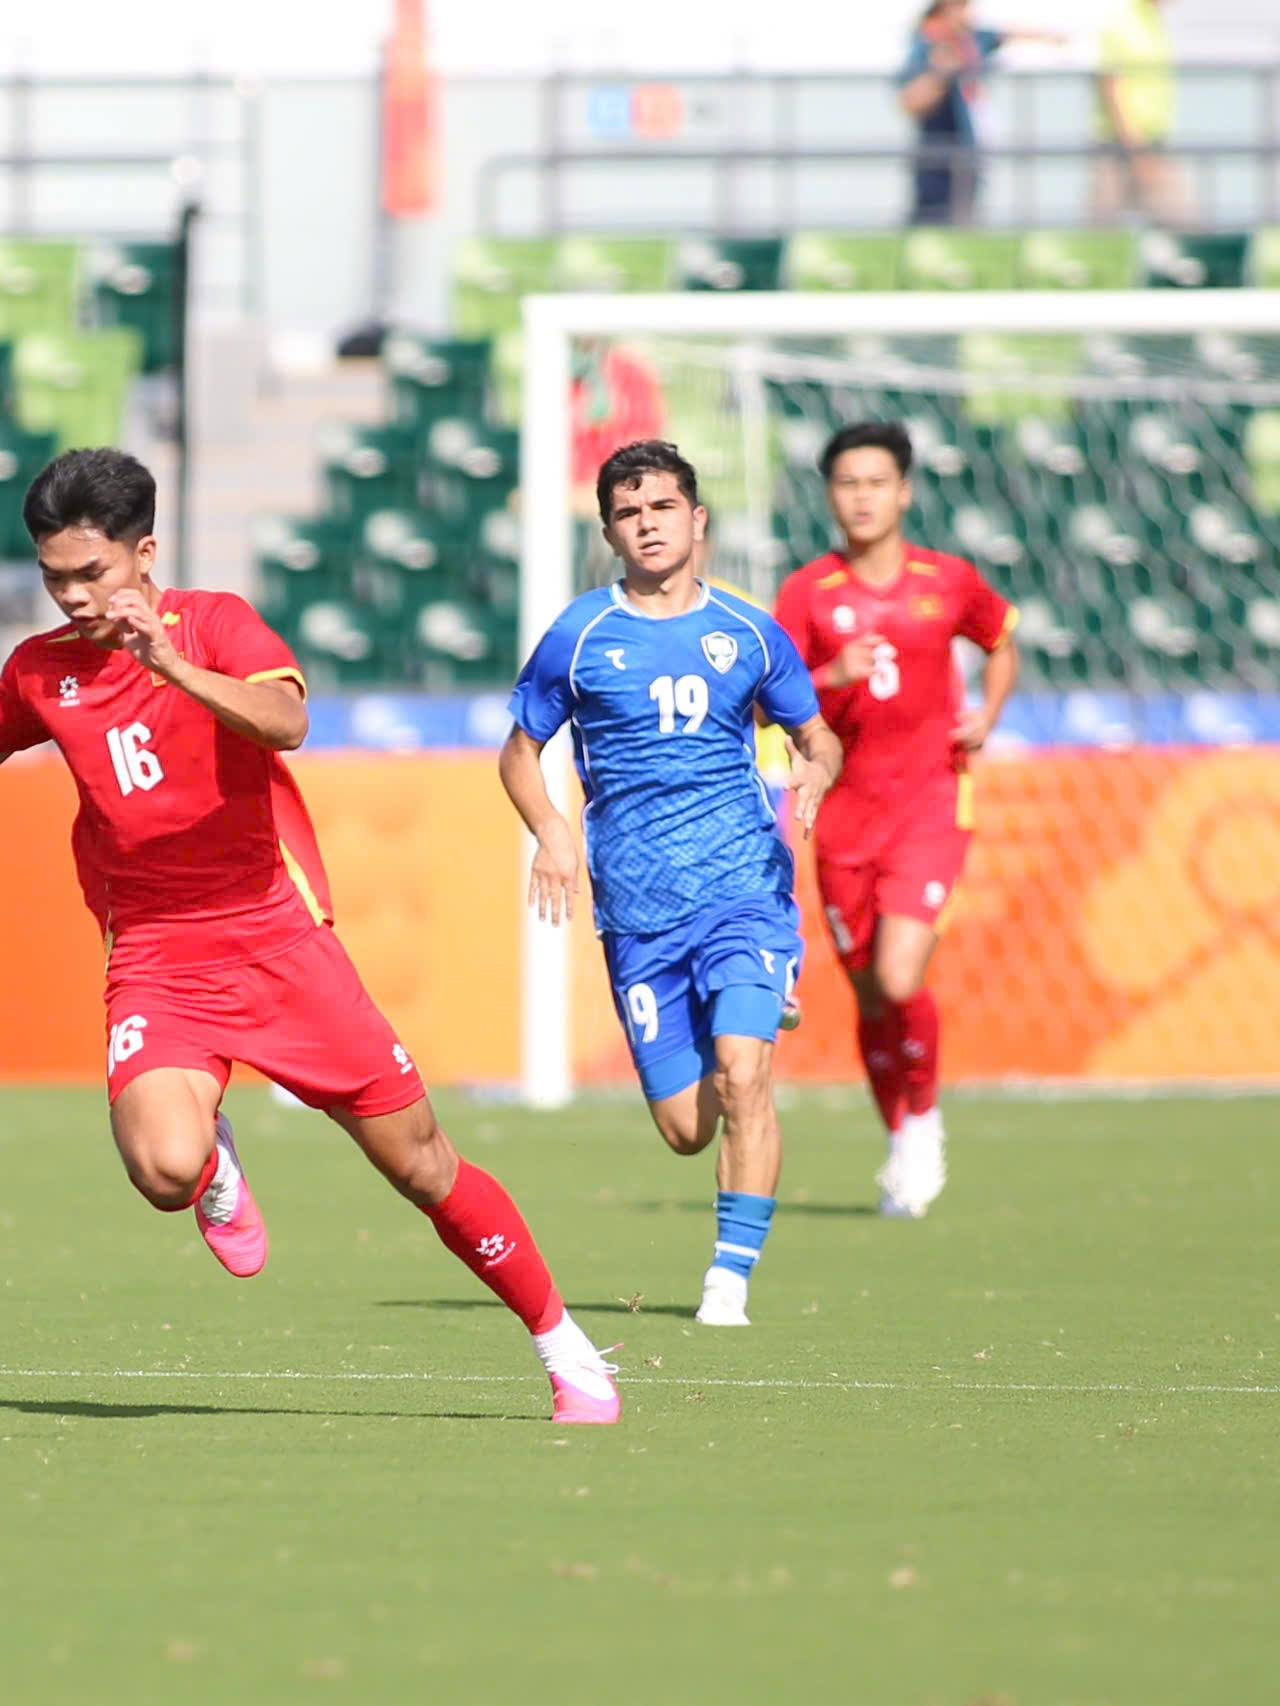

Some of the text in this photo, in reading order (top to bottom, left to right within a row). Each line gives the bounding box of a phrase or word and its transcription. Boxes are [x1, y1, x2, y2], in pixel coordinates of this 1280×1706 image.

[648, 674, 709, 735] 19
[105, 720, 166, 797] 16
[107, 1014, 149, 1078] 16
